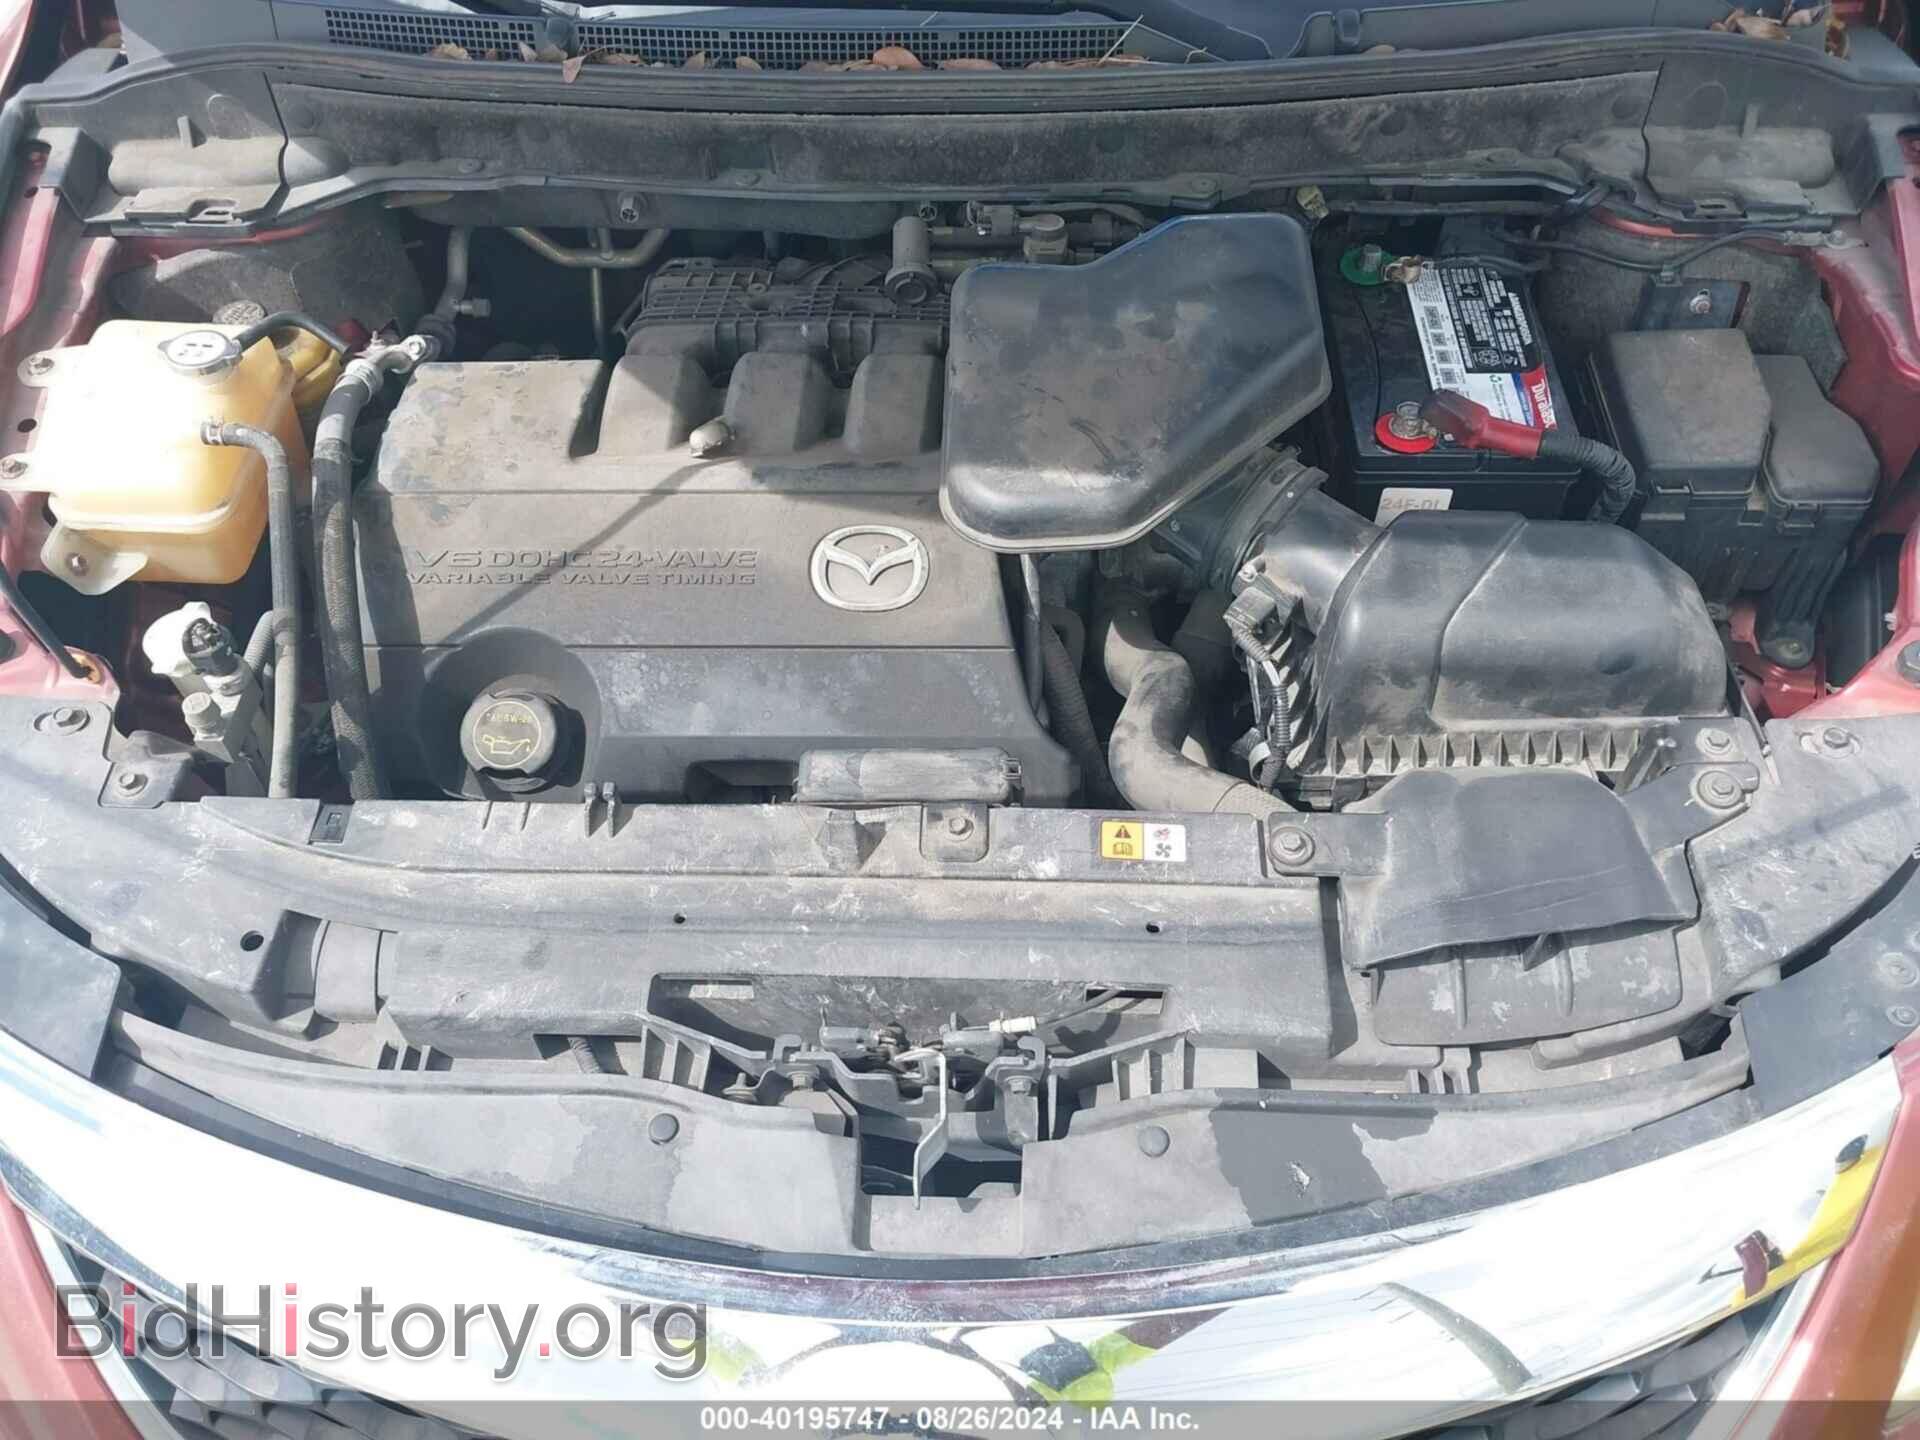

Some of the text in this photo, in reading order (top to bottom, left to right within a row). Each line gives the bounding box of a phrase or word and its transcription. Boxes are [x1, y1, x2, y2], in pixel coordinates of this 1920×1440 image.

[1531, 380, 1557, 429] Duralast
[415, 549, 758, 568] V6 DOHC 24-VALVE
[408, 573, 756, 585] VARIABLE VALVE TIMING
